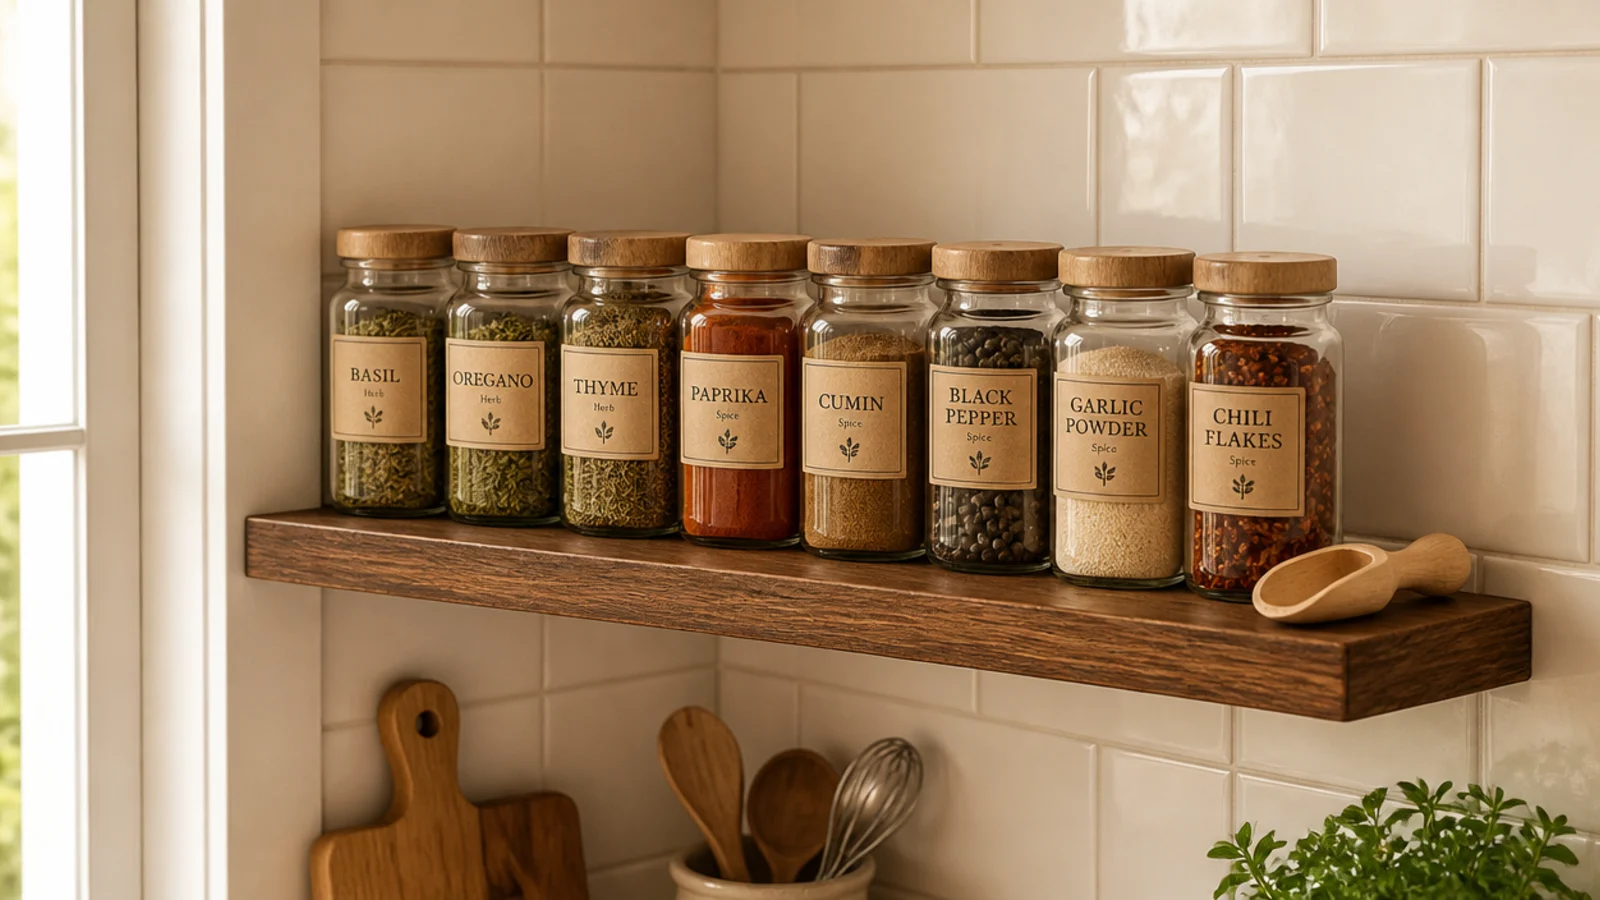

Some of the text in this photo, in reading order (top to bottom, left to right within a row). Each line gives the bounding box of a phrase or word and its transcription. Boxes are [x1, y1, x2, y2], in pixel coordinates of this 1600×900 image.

[350, 367, 401, 383] BASIL
[452, 370, 534, 389] OREGANO
[573, 378, 639, 397] THYME
[691, 385, 768, 404] PAPRIKA
[949, 386, 1013, 406] BLACK
[480, 394, 501, 404] Herb
[818, 393, 884, 412] CUMIN
[1070, 396, 1143, 416] GARLIC
[716, 409, 739, 422] Spice
[945, 407, 1018, 427] PEPPER
[1213, 407, 1272, 427] CHILI
[1065, 417, 1148, 437] POWDER
[967, 432, 991, 444] Spice
[1204, 429, 1283, 450] FLAKES
[1230, 455, 1256, 468] Spice
